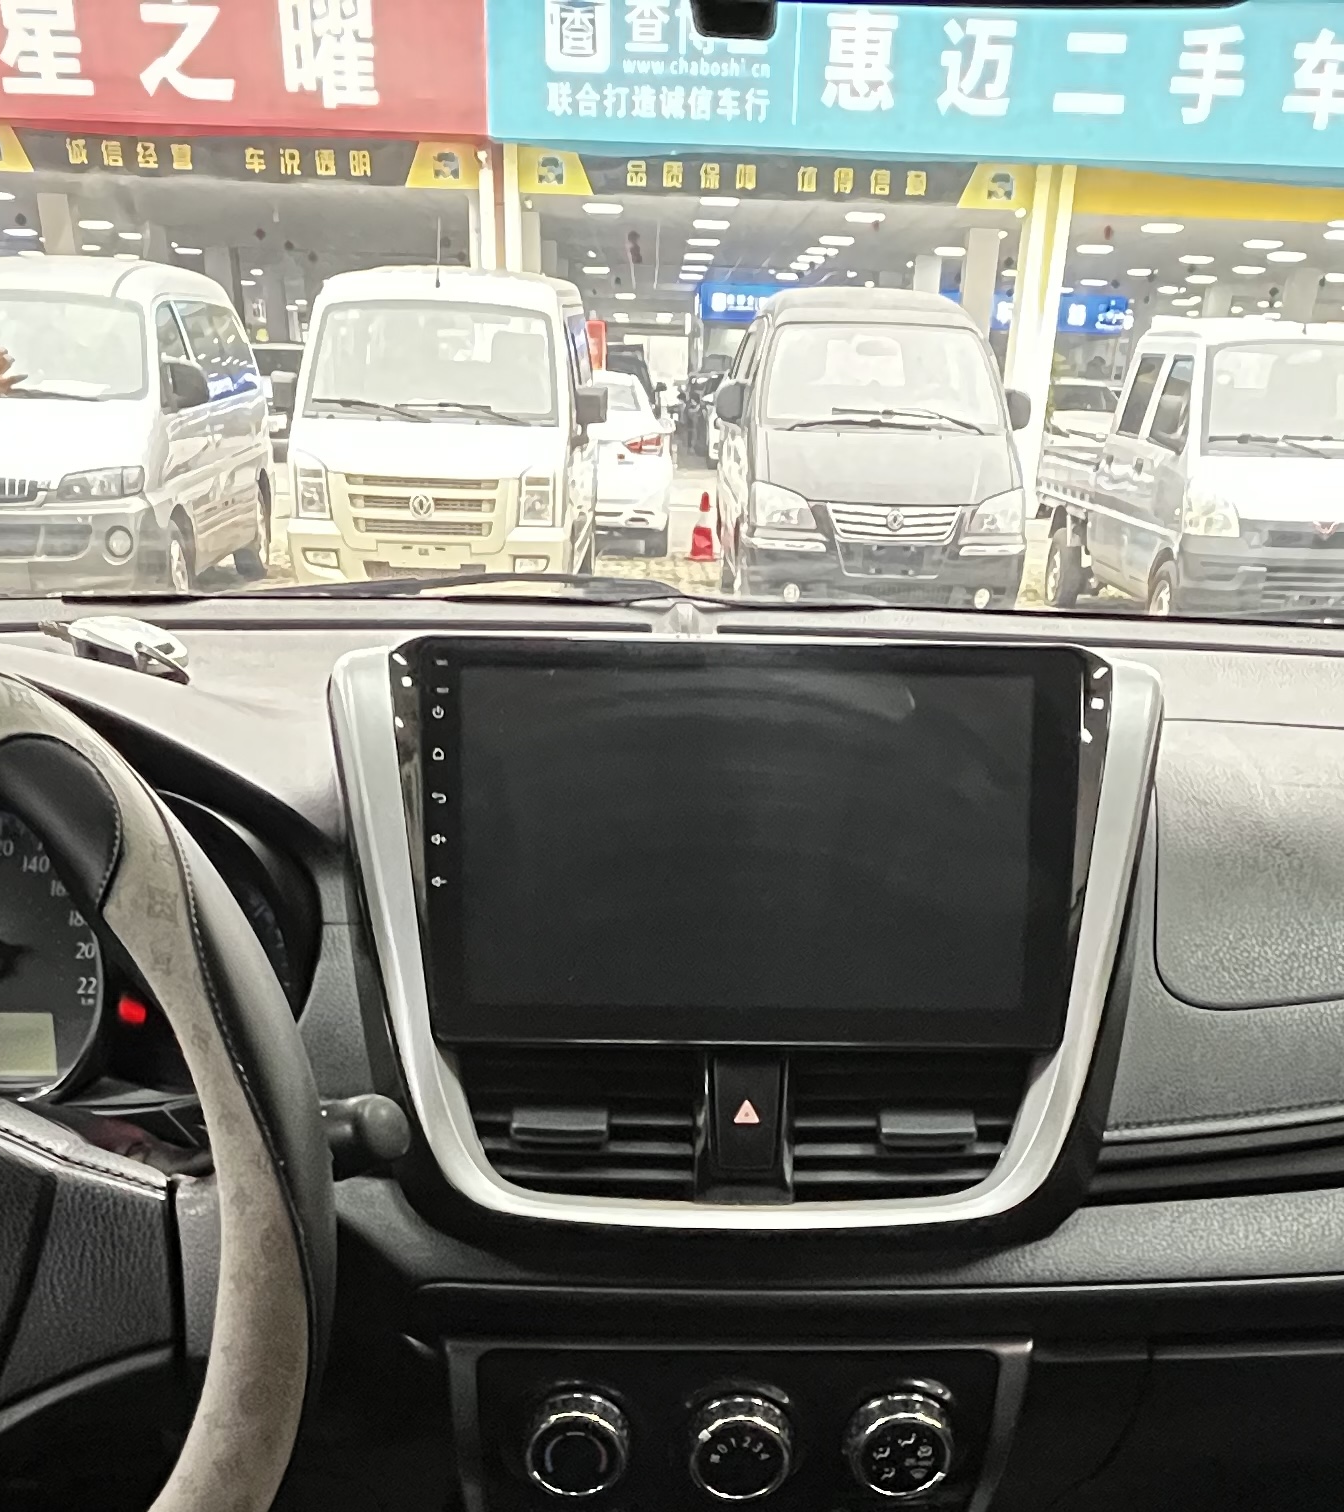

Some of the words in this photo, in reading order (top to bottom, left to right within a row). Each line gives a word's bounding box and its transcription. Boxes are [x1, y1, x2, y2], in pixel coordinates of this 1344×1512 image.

[0, 0, 380, 109] 星之曜
[546, 81, 771, 123] 联合打造诚信车行
[22, 856, 51, 873] 140
[50, 879, 69, 897] 16
